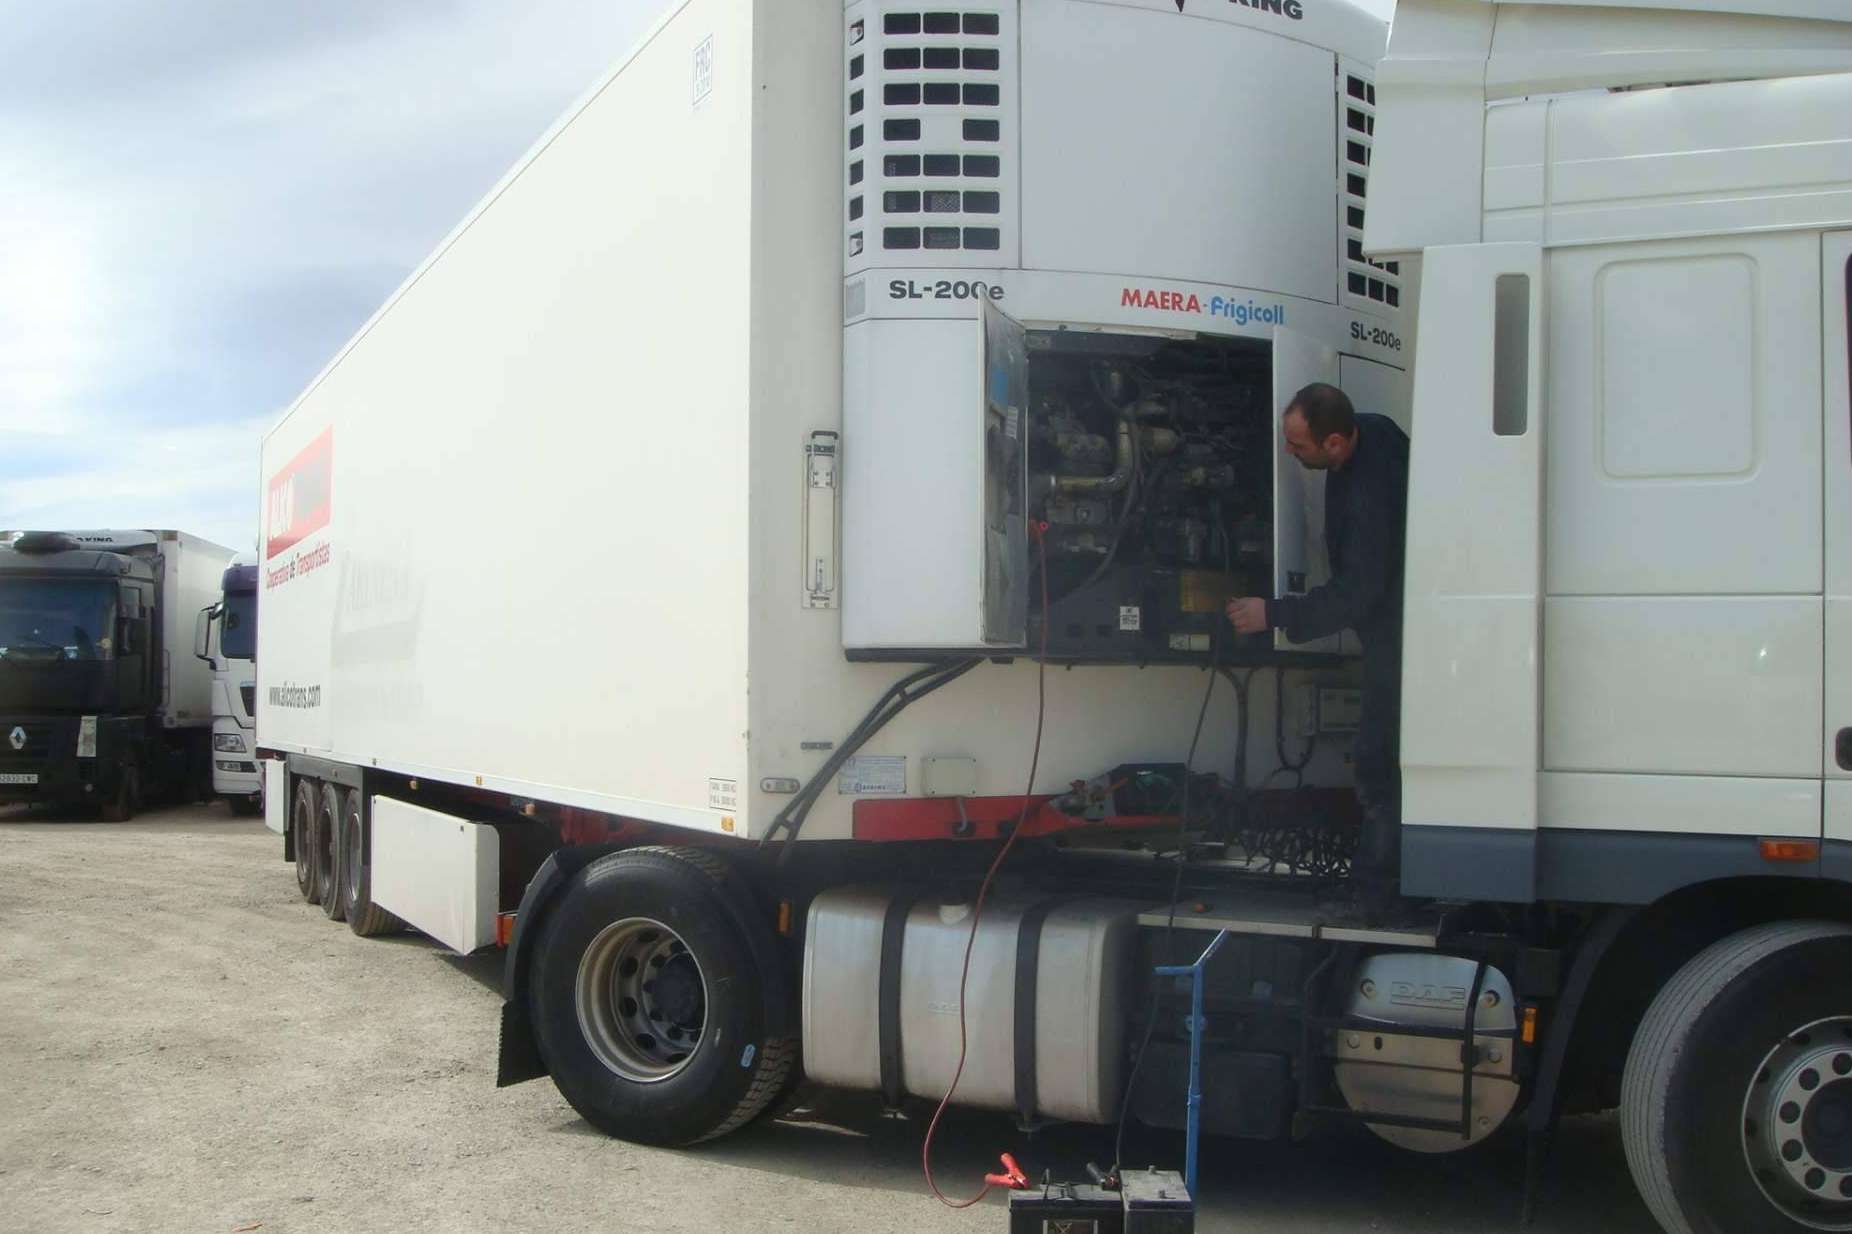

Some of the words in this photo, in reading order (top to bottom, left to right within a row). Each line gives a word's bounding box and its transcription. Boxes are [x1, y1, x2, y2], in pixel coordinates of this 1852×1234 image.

[889, 280, 1004, 300] SL-200e
[1350, 321, 1401, 351] SL-200e
[1392, 981, 1465, 1002] DAF
